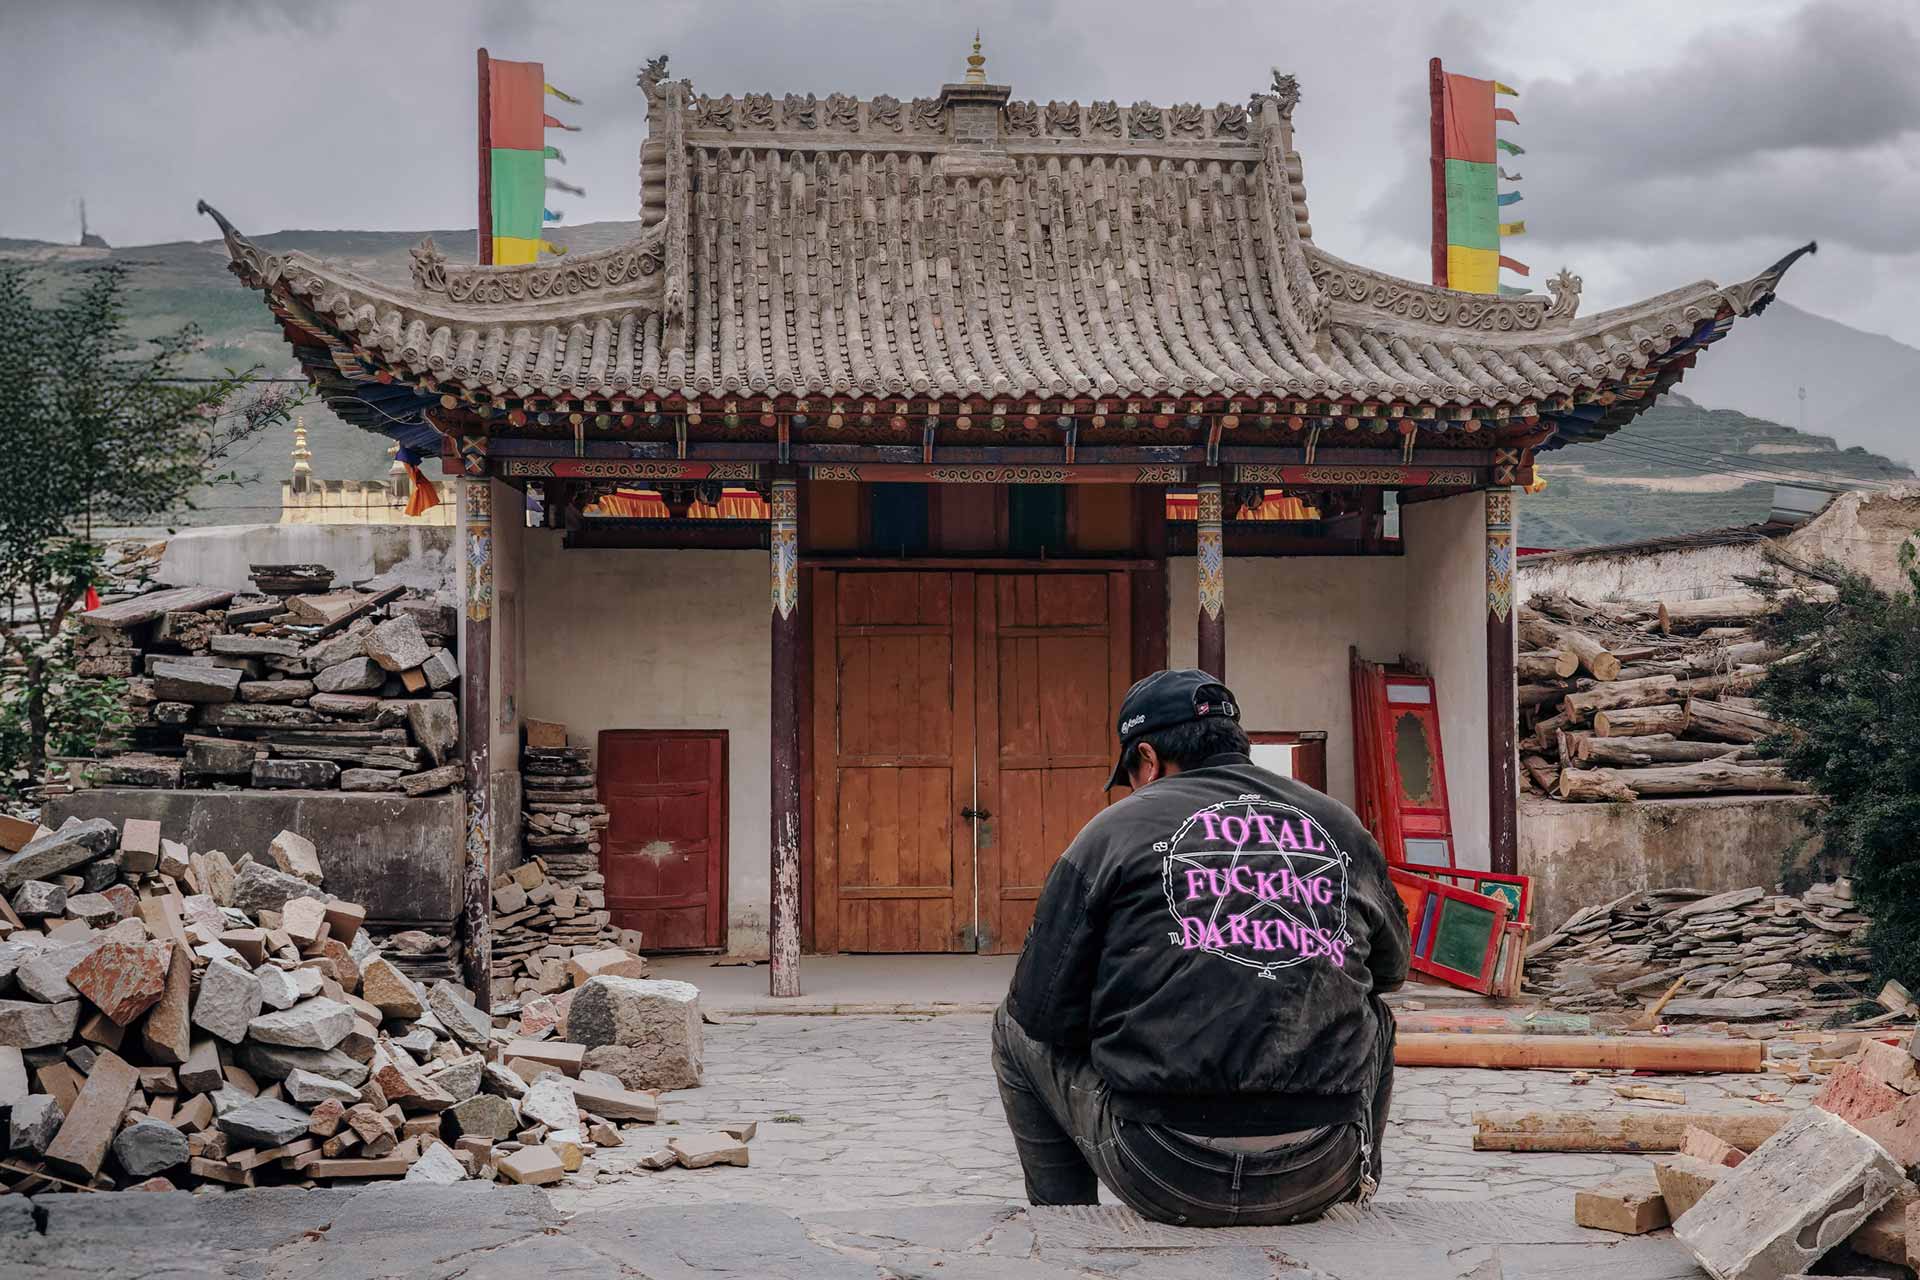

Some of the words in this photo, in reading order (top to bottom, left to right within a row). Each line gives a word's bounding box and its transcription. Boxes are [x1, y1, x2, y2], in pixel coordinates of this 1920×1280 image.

[1194, 812, 1325, 851] TOTAL
[1184, 865, 1333, 905] FUCKING
[1181, 914, 1346, 967] DARKNESS
